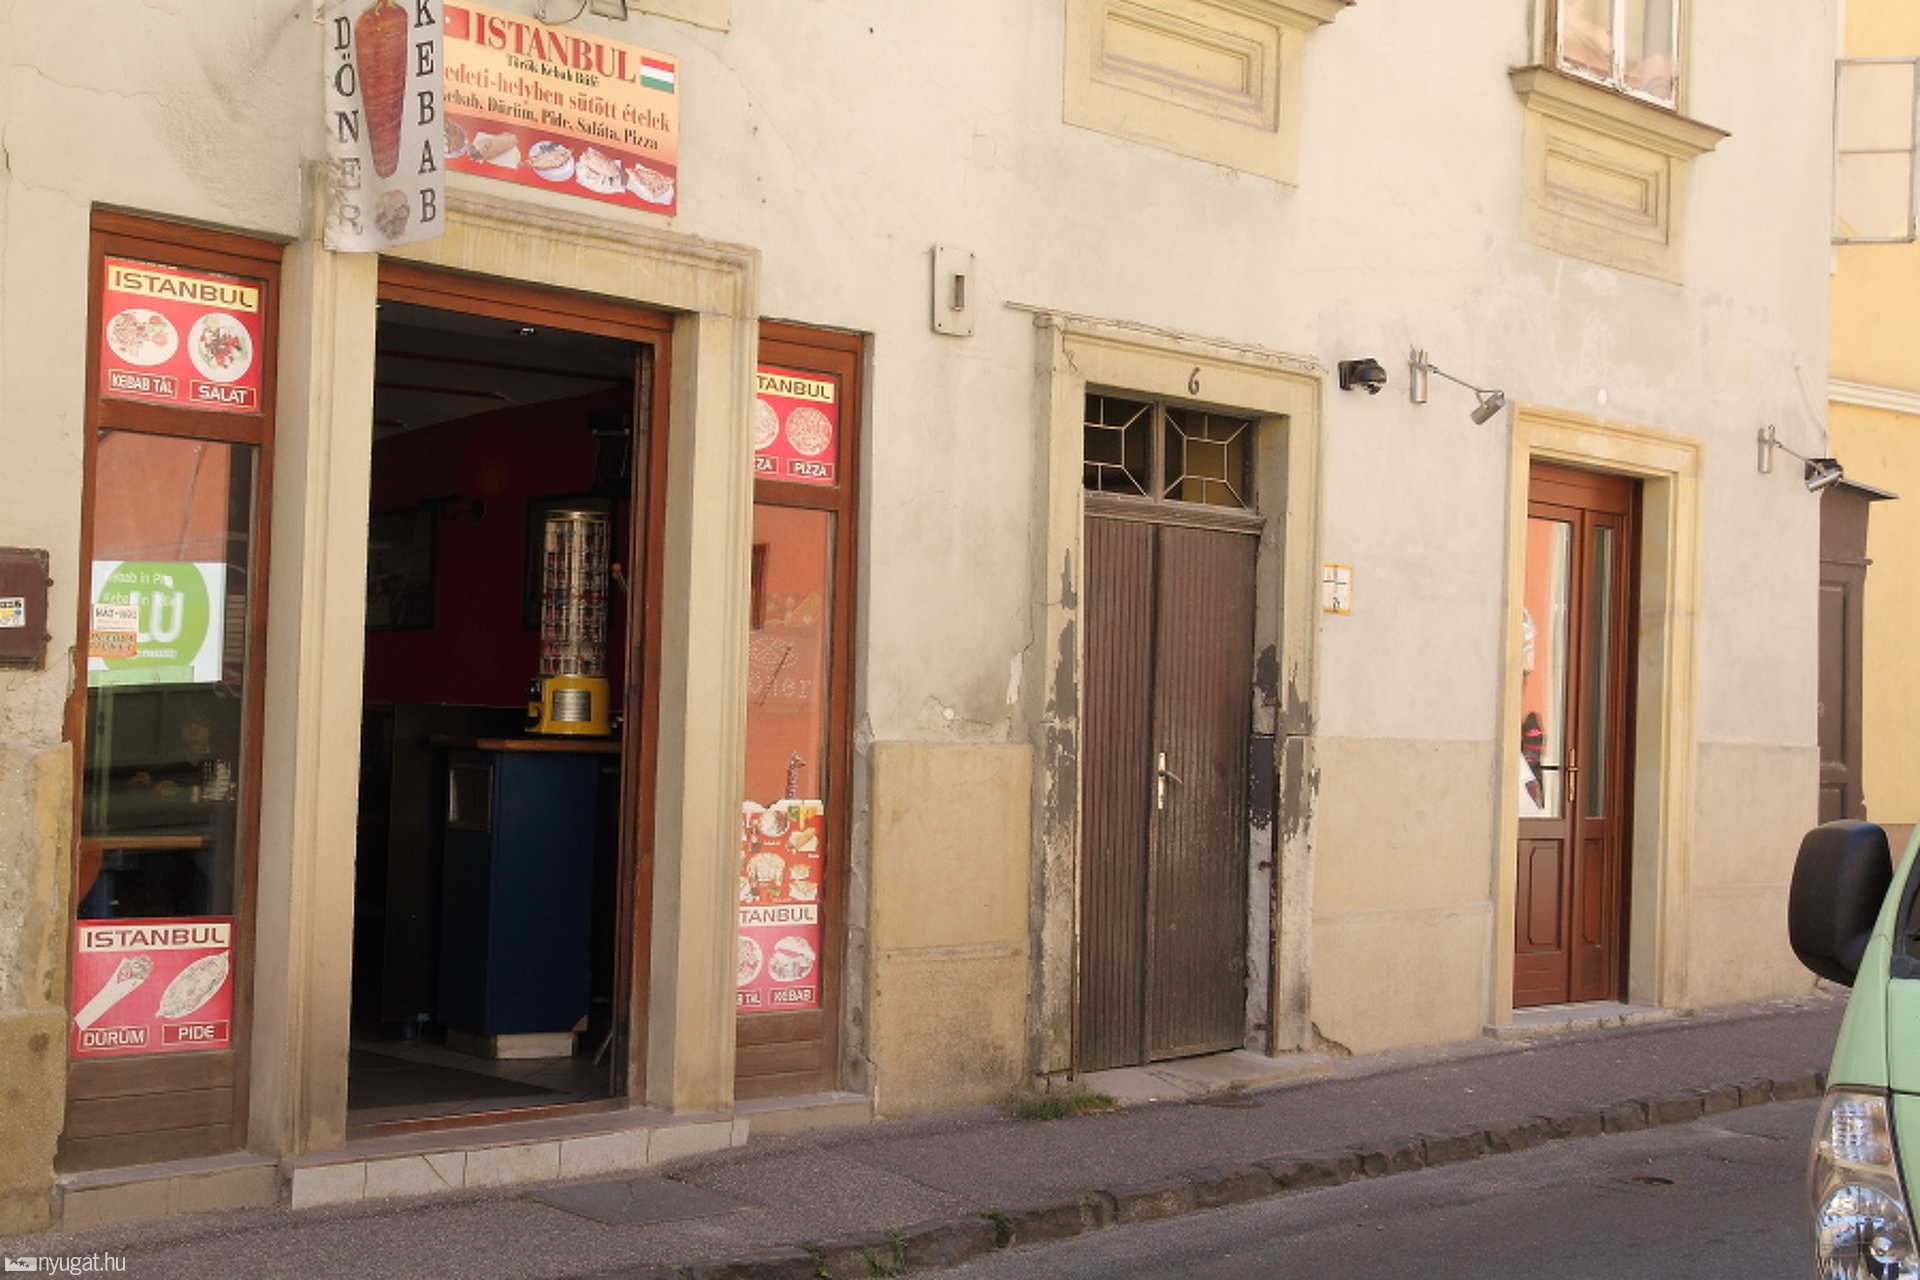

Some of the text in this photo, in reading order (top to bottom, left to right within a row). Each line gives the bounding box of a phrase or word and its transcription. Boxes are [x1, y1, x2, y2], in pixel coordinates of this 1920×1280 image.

[475, 12, 637, 84] ISTANBUL
[443, 63, 563, 108] edeti-helyben
[622, 103, 671, 132] ételek
[413, 0, 437, 223] KEBAB
[443, 89, 483, 110] ebab,
[623, 127, 658, 151] Pizza
[333, 16, 364, 236] DÖNER
[115, 270, 253, 309] ISTANBUL
[112, 373, 150, 391] KEBAB
[757, 375, 831, 400] TANBUL
[1188, 367, 1201, 395] 6
[199, 385, 247, 404] SALAT
[795, 462, 826, 477] PIZZA
[740, 908, 813, 923] TANBUL
[87, 928, 224, 948] ISTANBUL
[774, 989, 811, 1002] KEBAB
[178, 1026, 214, 1040] PIDE
